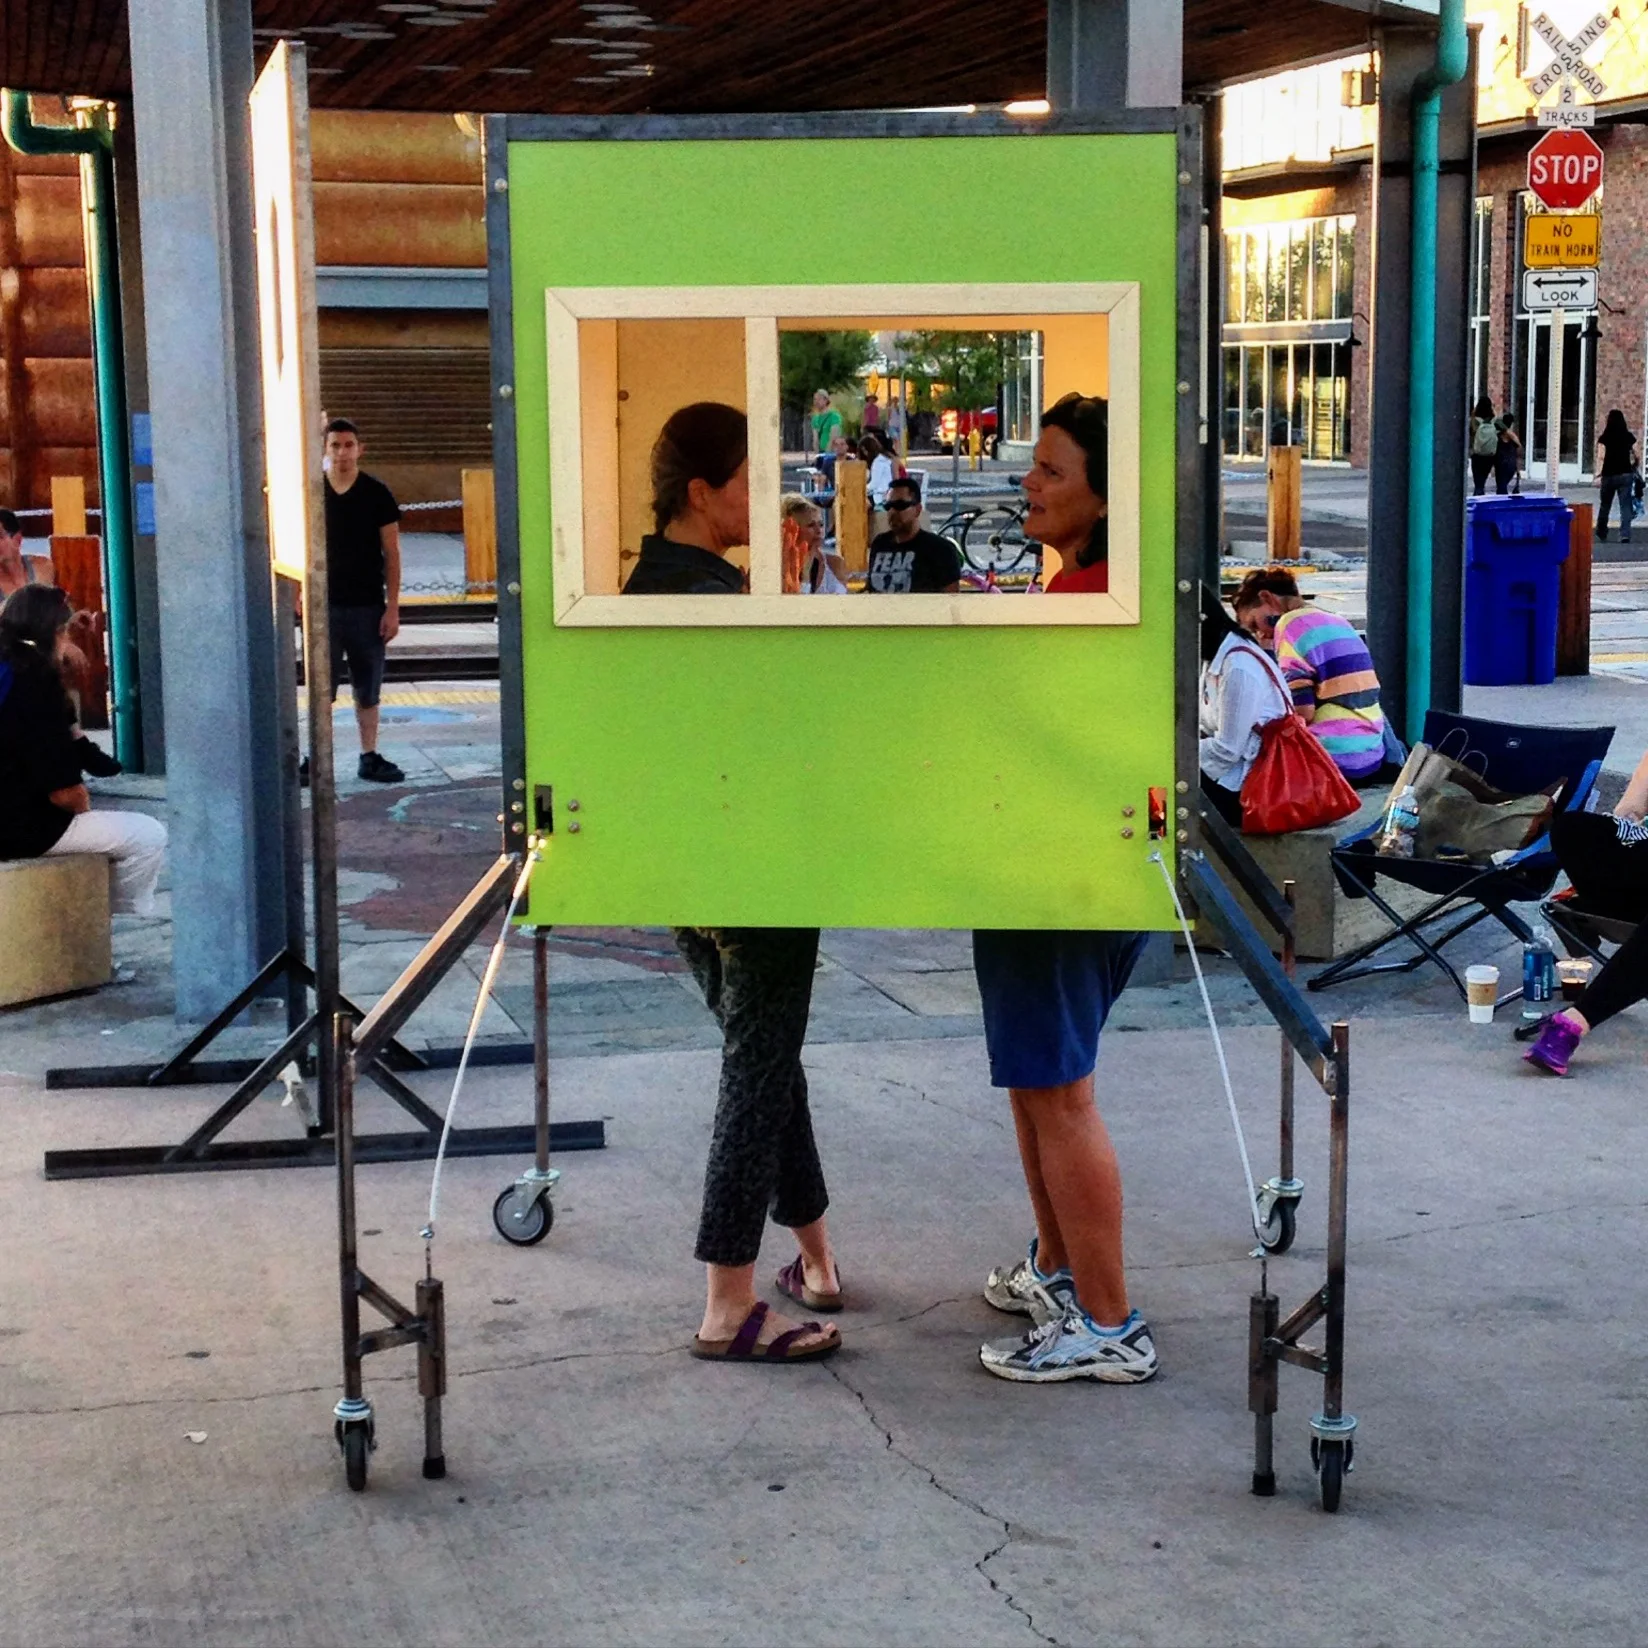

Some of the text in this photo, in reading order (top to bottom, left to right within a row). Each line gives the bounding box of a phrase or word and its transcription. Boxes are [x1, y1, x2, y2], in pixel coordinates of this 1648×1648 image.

[1532, 16, 1607, 95] CROSSING
[1563, 89, 1572, 103] 2
[1545, 111, 1588, 122] TRACKS
[1532, 154, 1600, 184] STOP
[1553, 224, 1573, 237] NO
[1531, 244, 1595, 256] TRAIN HORN
[1541, 291, 1579, 301] LOOK
[872, 551, 915, 572] FEAR
